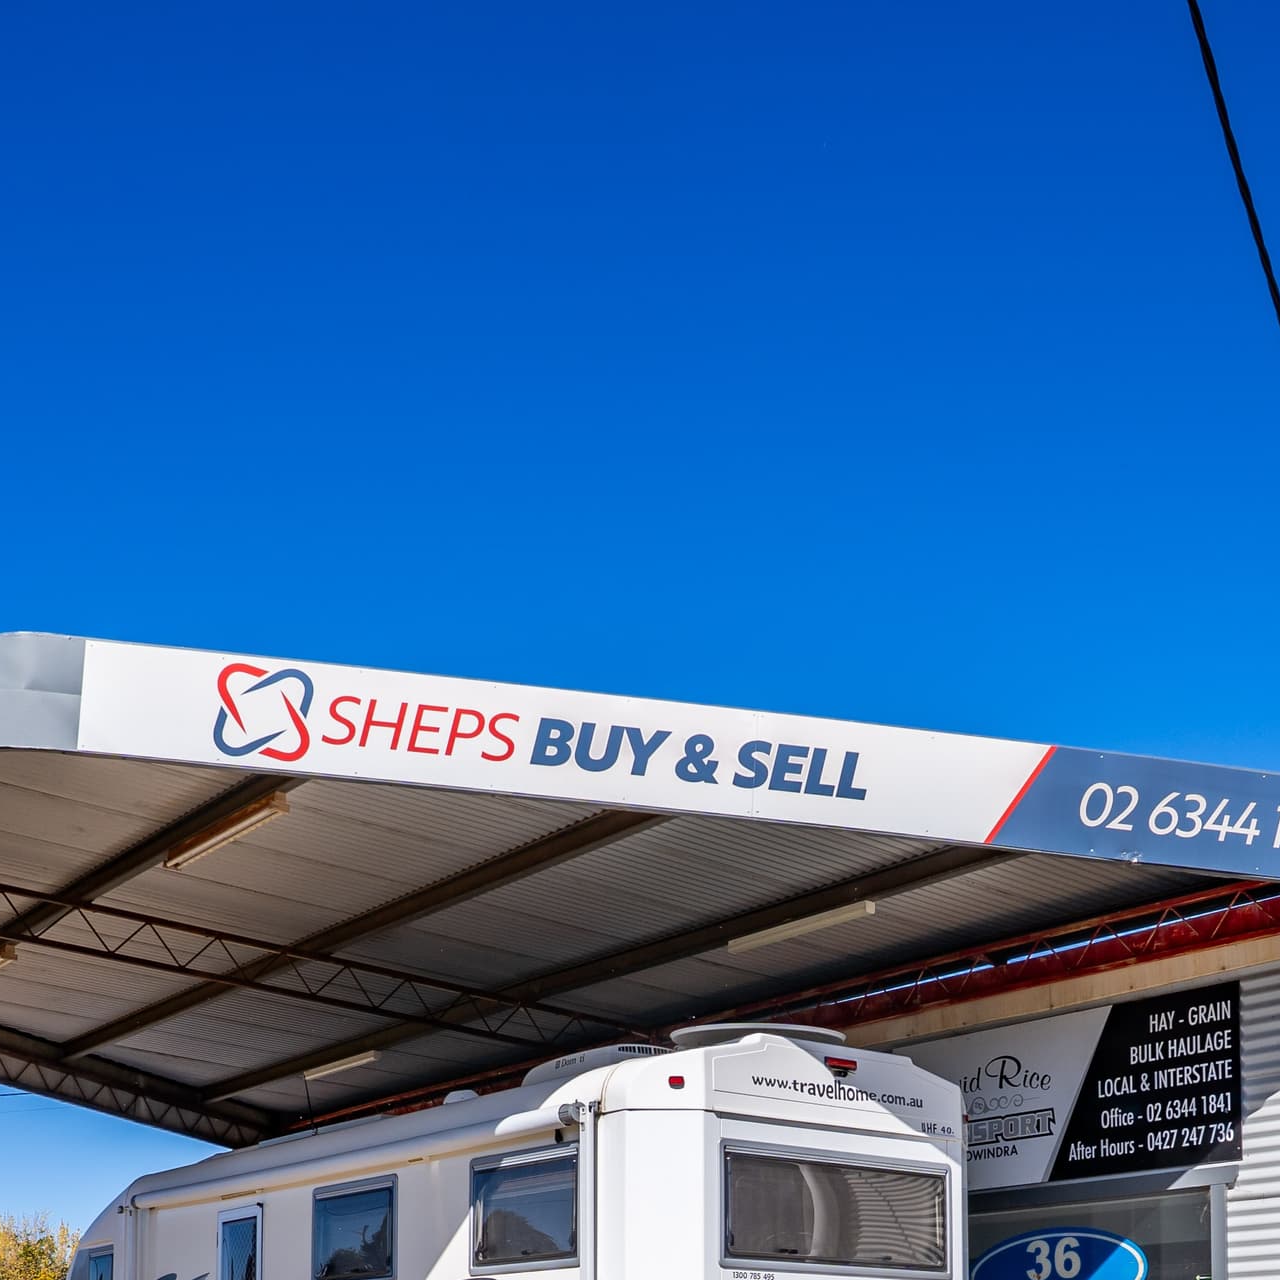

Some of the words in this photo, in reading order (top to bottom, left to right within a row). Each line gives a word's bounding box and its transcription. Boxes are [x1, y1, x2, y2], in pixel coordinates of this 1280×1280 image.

[322, 696, 519, 762] SHEPS
[531, 719, 671, 776] BUY
[675, 735, 718, 785] &
[734, 740, 867, 801] SELL
[1079, 782, 1140, 832] 02
[1148, 791, 1261, 846] 6344
[1149, 1010, 1176, 1034] HAY
[1187, 999, 1231, 1026] GRAIN
[1130, 1041, 1164, 1065] BULK
[1168, 1029, 1232, 1059] HAULAGE
[985, 1055, 1051, 1091] Rice
[1097, 1075, 1137, 1099] LOCAL
[1140, 1072, 1151, 1092] &
[1154, 1058, 1233, 1090] INTERSTATE
[752, 1075, 923, 1109] www.travelhome.com.au
[1100, 1108, 1135, 1129] Office
[1146, 1102, 1162, 1123] 02
[1165, 1097, 1197, 1120] 6344
[1201, 1092, 1232, 1115] 1841
[1068, 1141, 1097, 1162] After
[1100, 1138, 1135, 1158] Hours
[1147, 1129, 1178, 1152] 0427
[1181, 1125, 1206, 1148] 247
[1209, 1122, 1235, 1144] 736
[732, 1271, 748, 1279] 1300
